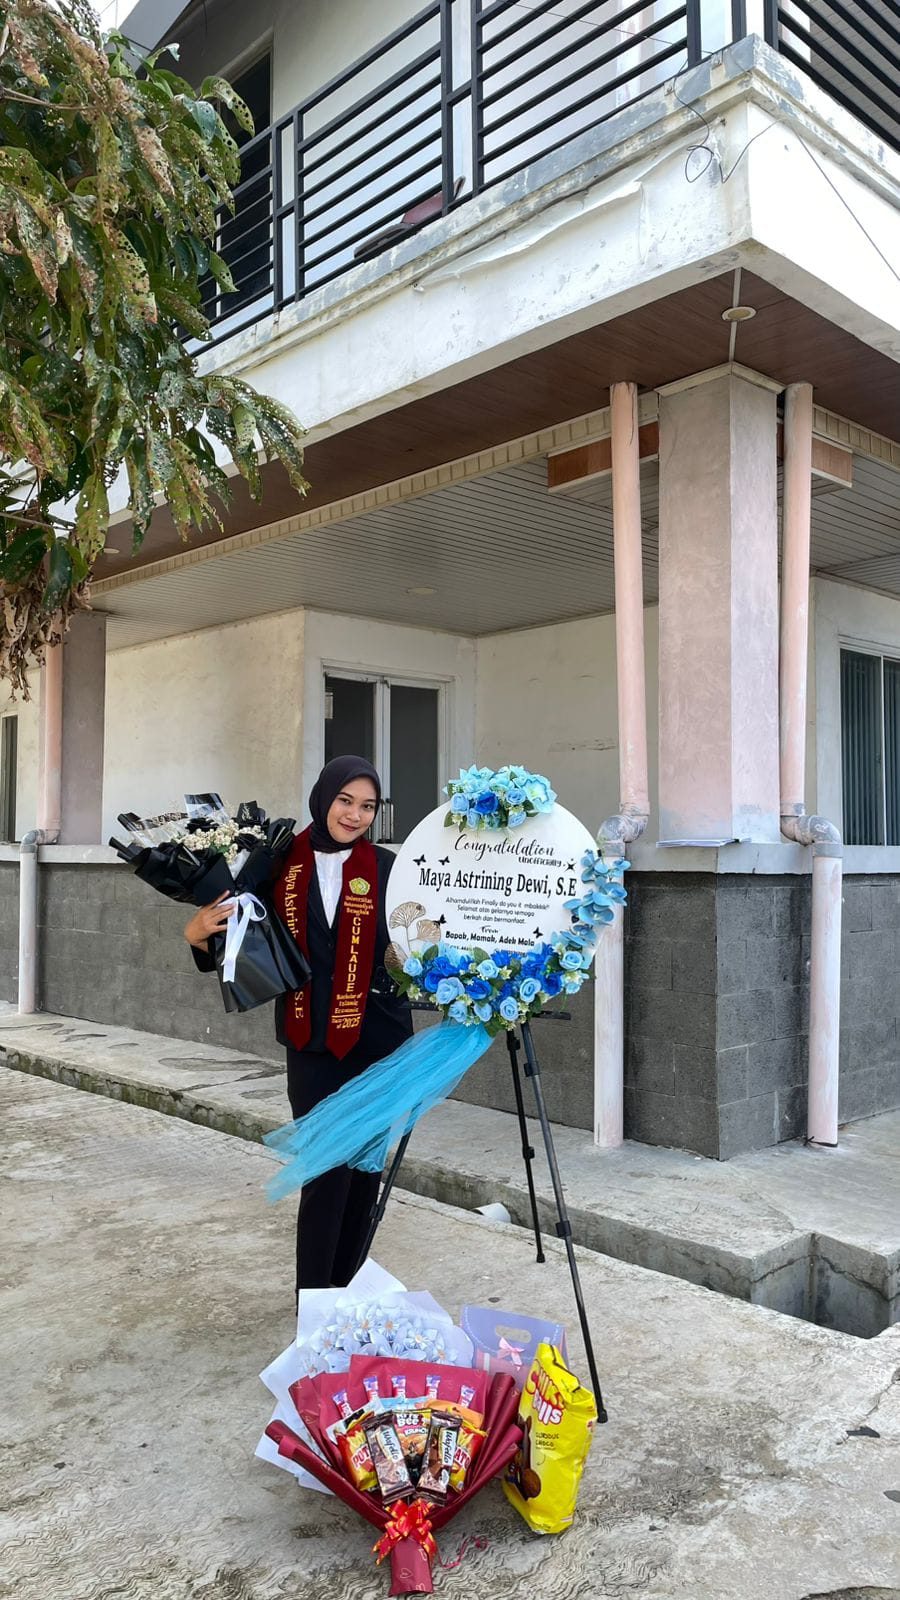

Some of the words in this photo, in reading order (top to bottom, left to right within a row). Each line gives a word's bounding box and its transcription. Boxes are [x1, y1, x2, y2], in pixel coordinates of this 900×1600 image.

[454, 833, 555, 862] Congratulation
[285, 864, 303, 890] Maya
[419, 868, 451, 892] Maya
[453, 869, 513, 897] Astrining
[516, 873, 552, 899] Dewi,
[556, 877, 578, 897] S.E
[285, 892, 299, 938] Astrini
[481, 898, 498, 907] Finally
[491, 907, 514, 915] gelarnya
